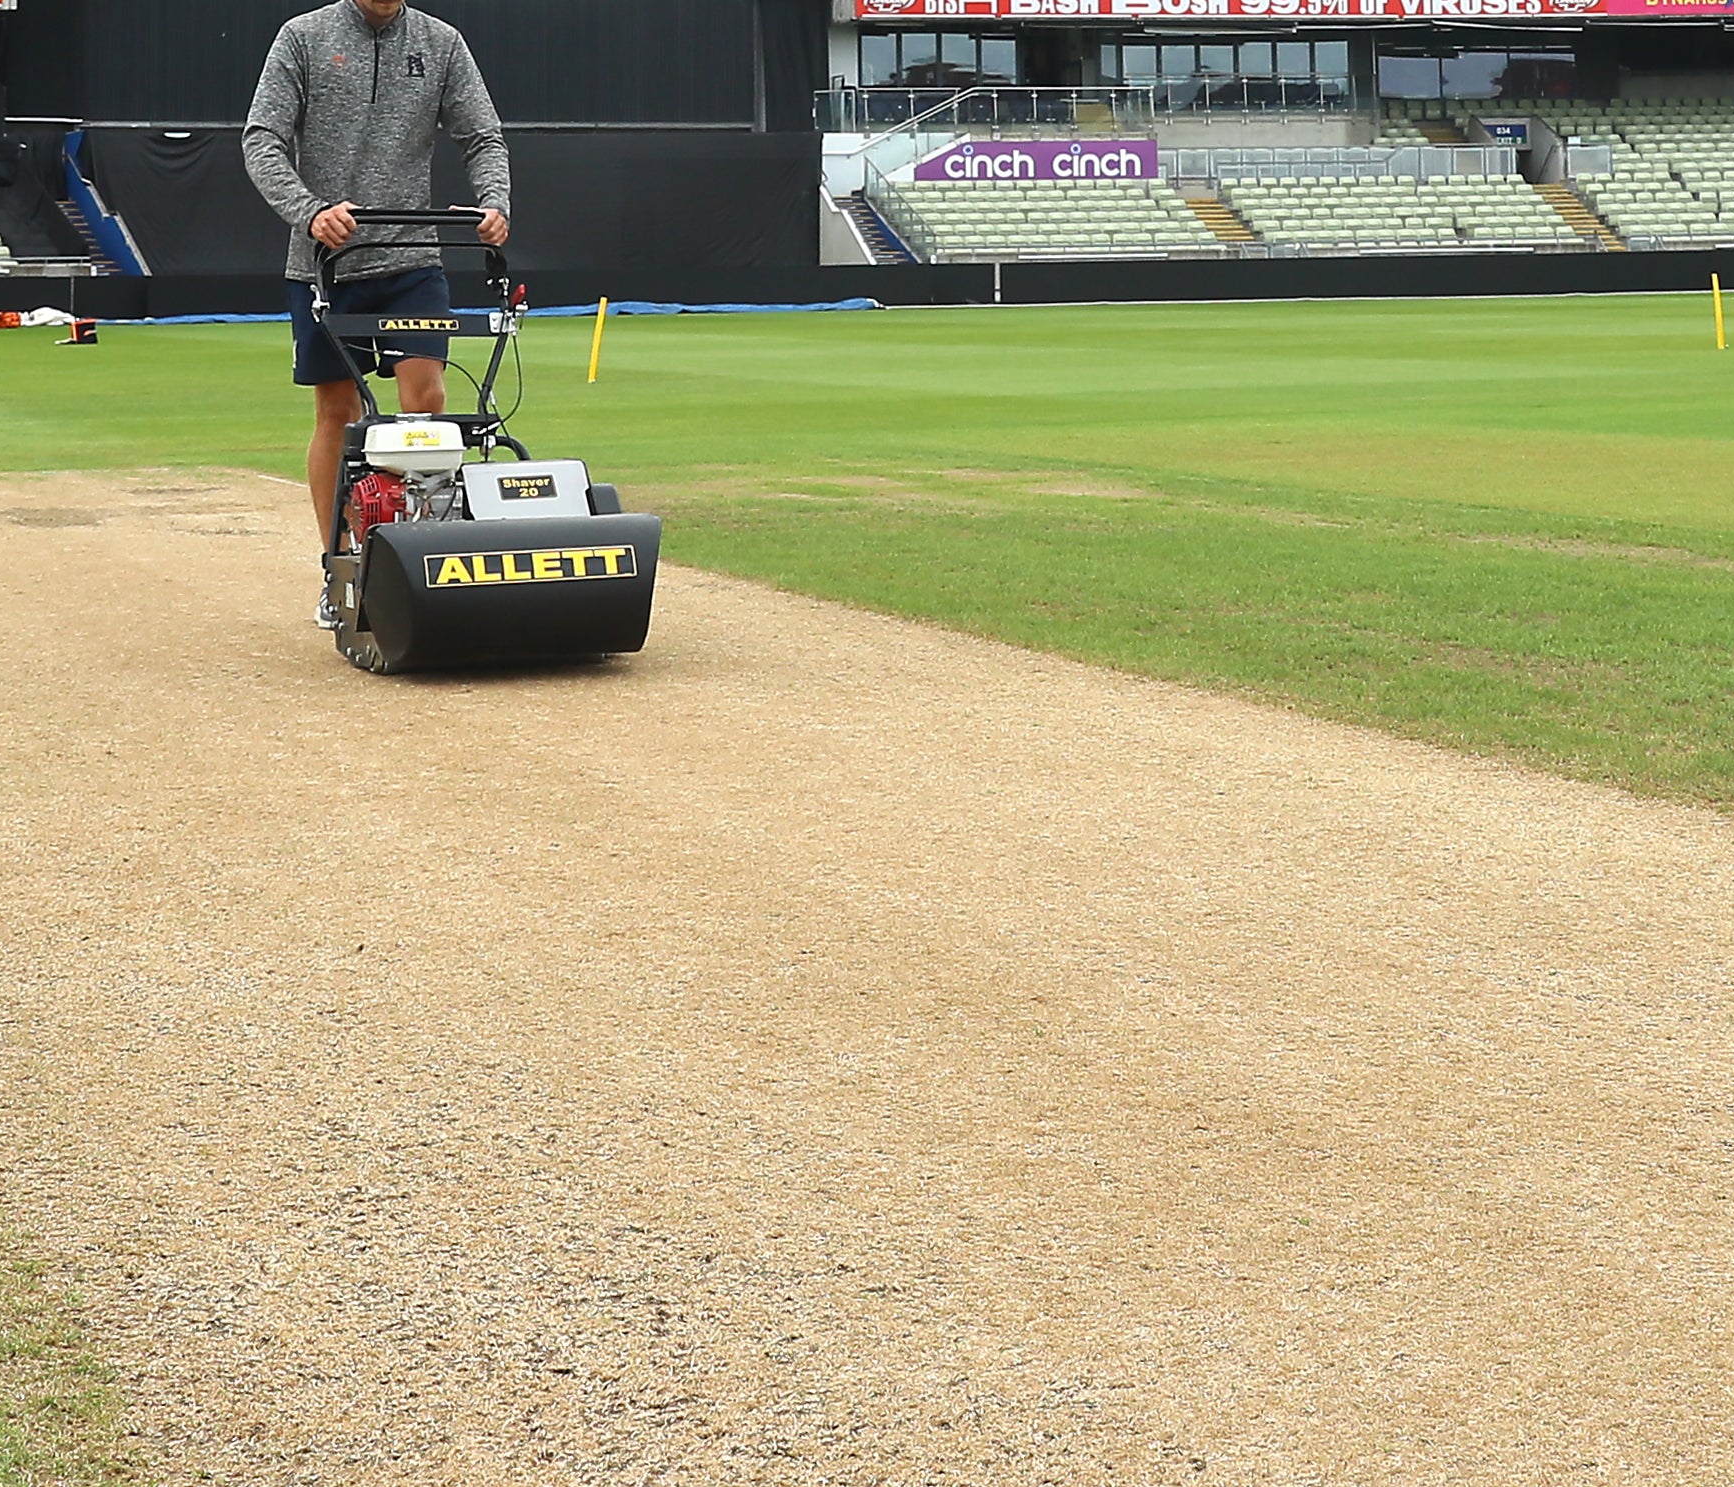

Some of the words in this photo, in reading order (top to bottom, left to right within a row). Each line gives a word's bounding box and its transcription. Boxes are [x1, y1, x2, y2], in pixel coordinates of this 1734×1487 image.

[1496, 126, 1511, 135] 034
[944, 144, 1035, 179] cinch
[1052, 143, 1141, 177] cinch
[384, 319, 454, 330] ALLETT
[518, 487, 540, 498] 20
[436, 548, 626, 585] ALLETT
